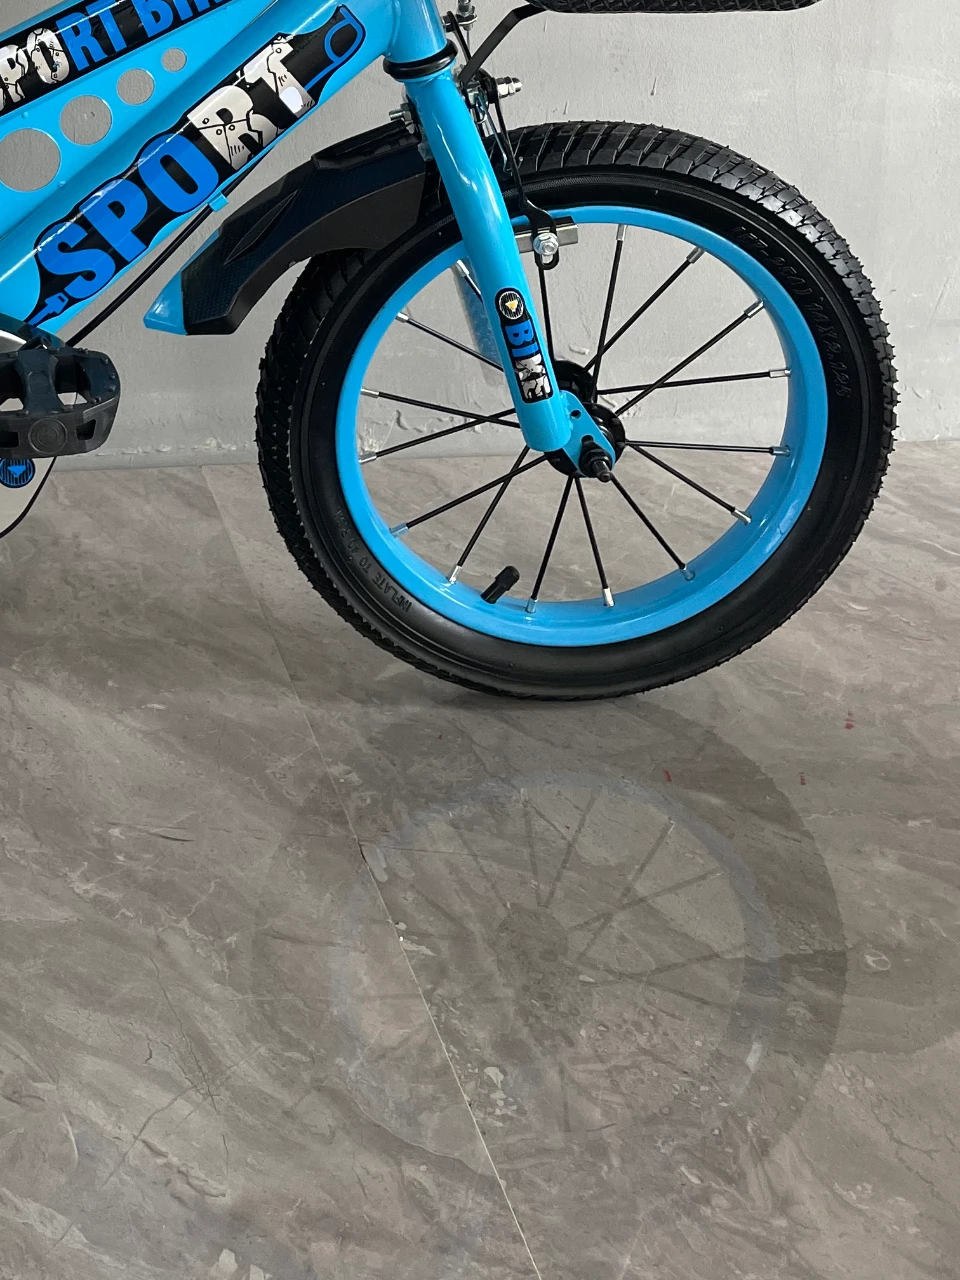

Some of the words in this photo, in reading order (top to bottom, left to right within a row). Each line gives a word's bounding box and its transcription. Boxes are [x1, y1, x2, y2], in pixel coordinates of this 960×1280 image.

[39, 35, 315, 302] SPORT
[504, 319, 551, 400] BIKE
[358, 555, 373, 573] TO
[371, 571, 413, 613] INFLATE
